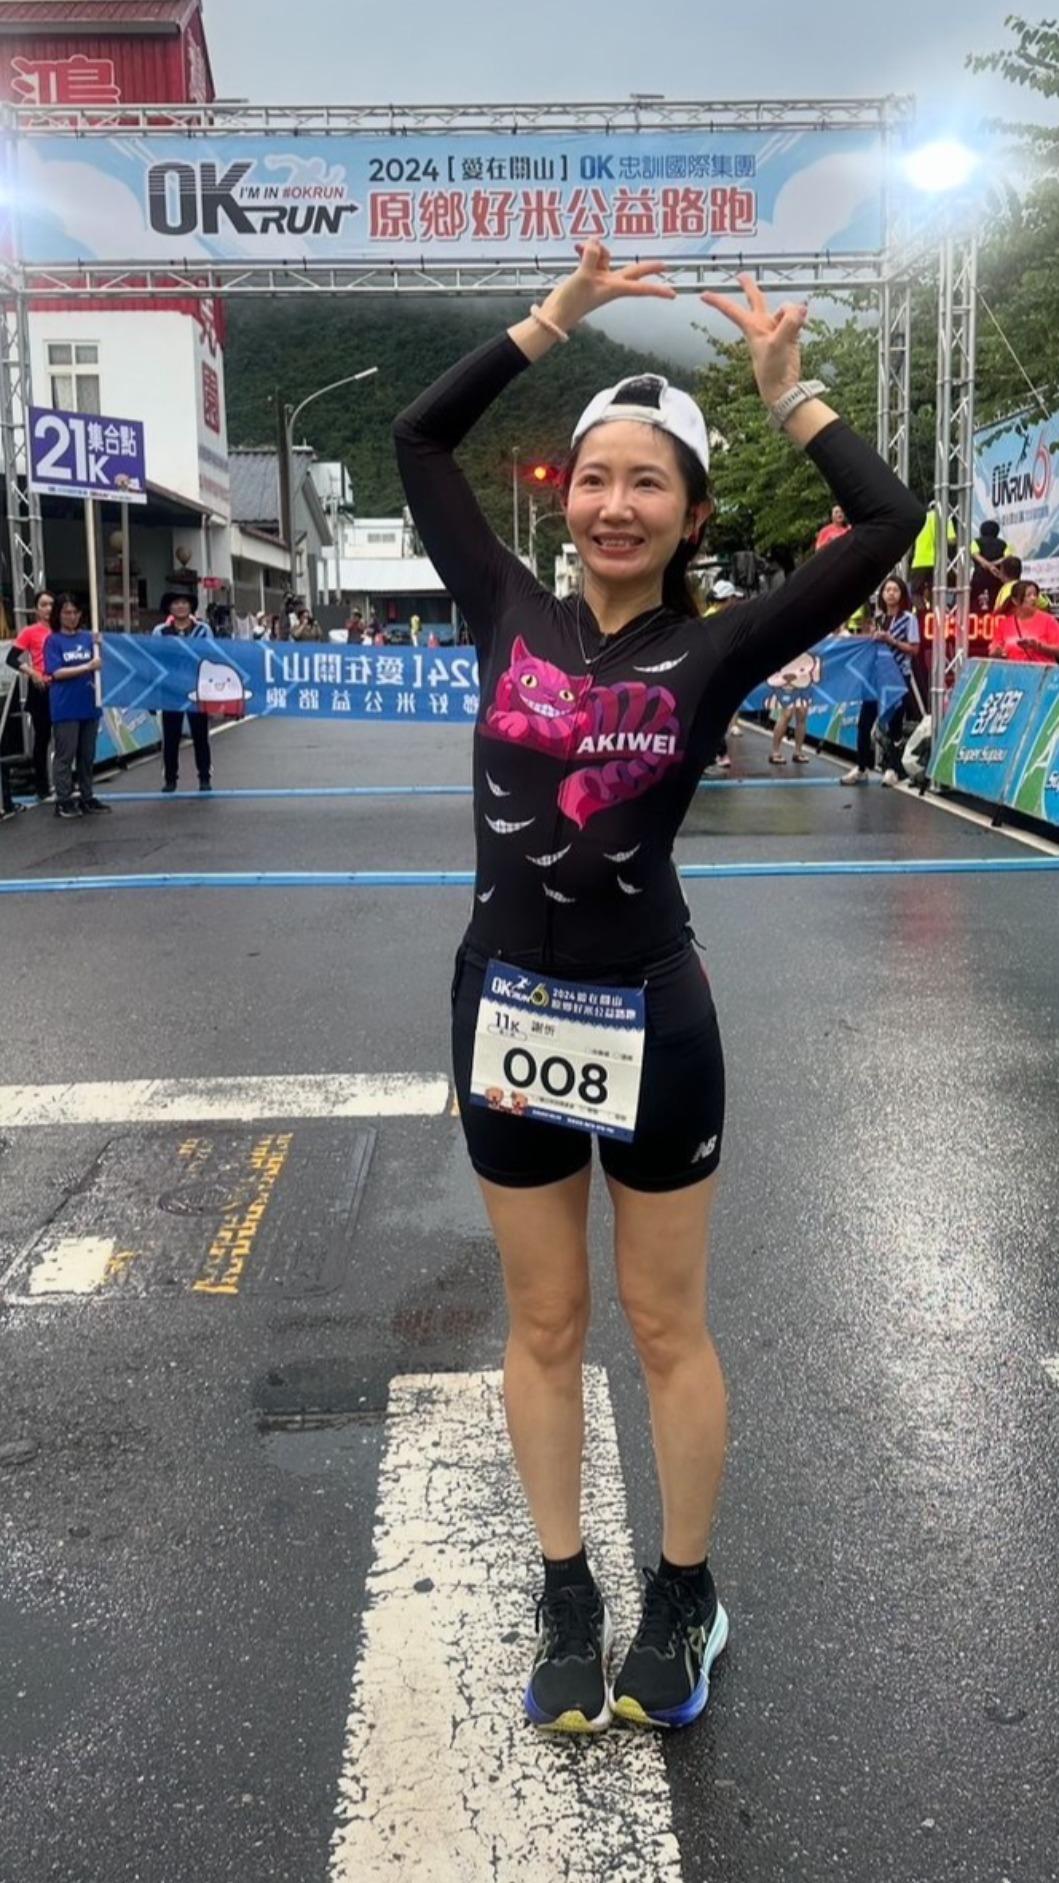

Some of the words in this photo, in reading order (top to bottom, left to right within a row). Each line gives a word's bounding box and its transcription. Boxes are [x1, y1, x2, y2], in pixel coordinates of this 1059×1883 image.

[369, 158, 439, 182] 2024
[580, 155, 615, 180] OK
[619, 154, 757, 179] 忠訓國際集團
[239, 187, 260, 199] I'M
[264, 187, 279, 199] IN
[282, 186, 344, 199] #OKRUN
[369, 186, 756, 239] 原鄉好米公益路跑
[87, 421, 137, 457] 集合點
[577, 732, 676, 755] AKIWEI
[552, 987, 576, 1002] 2024
[495, 1011, 520, 1033] 11K
[503, 1047, 608, 1105] 008
